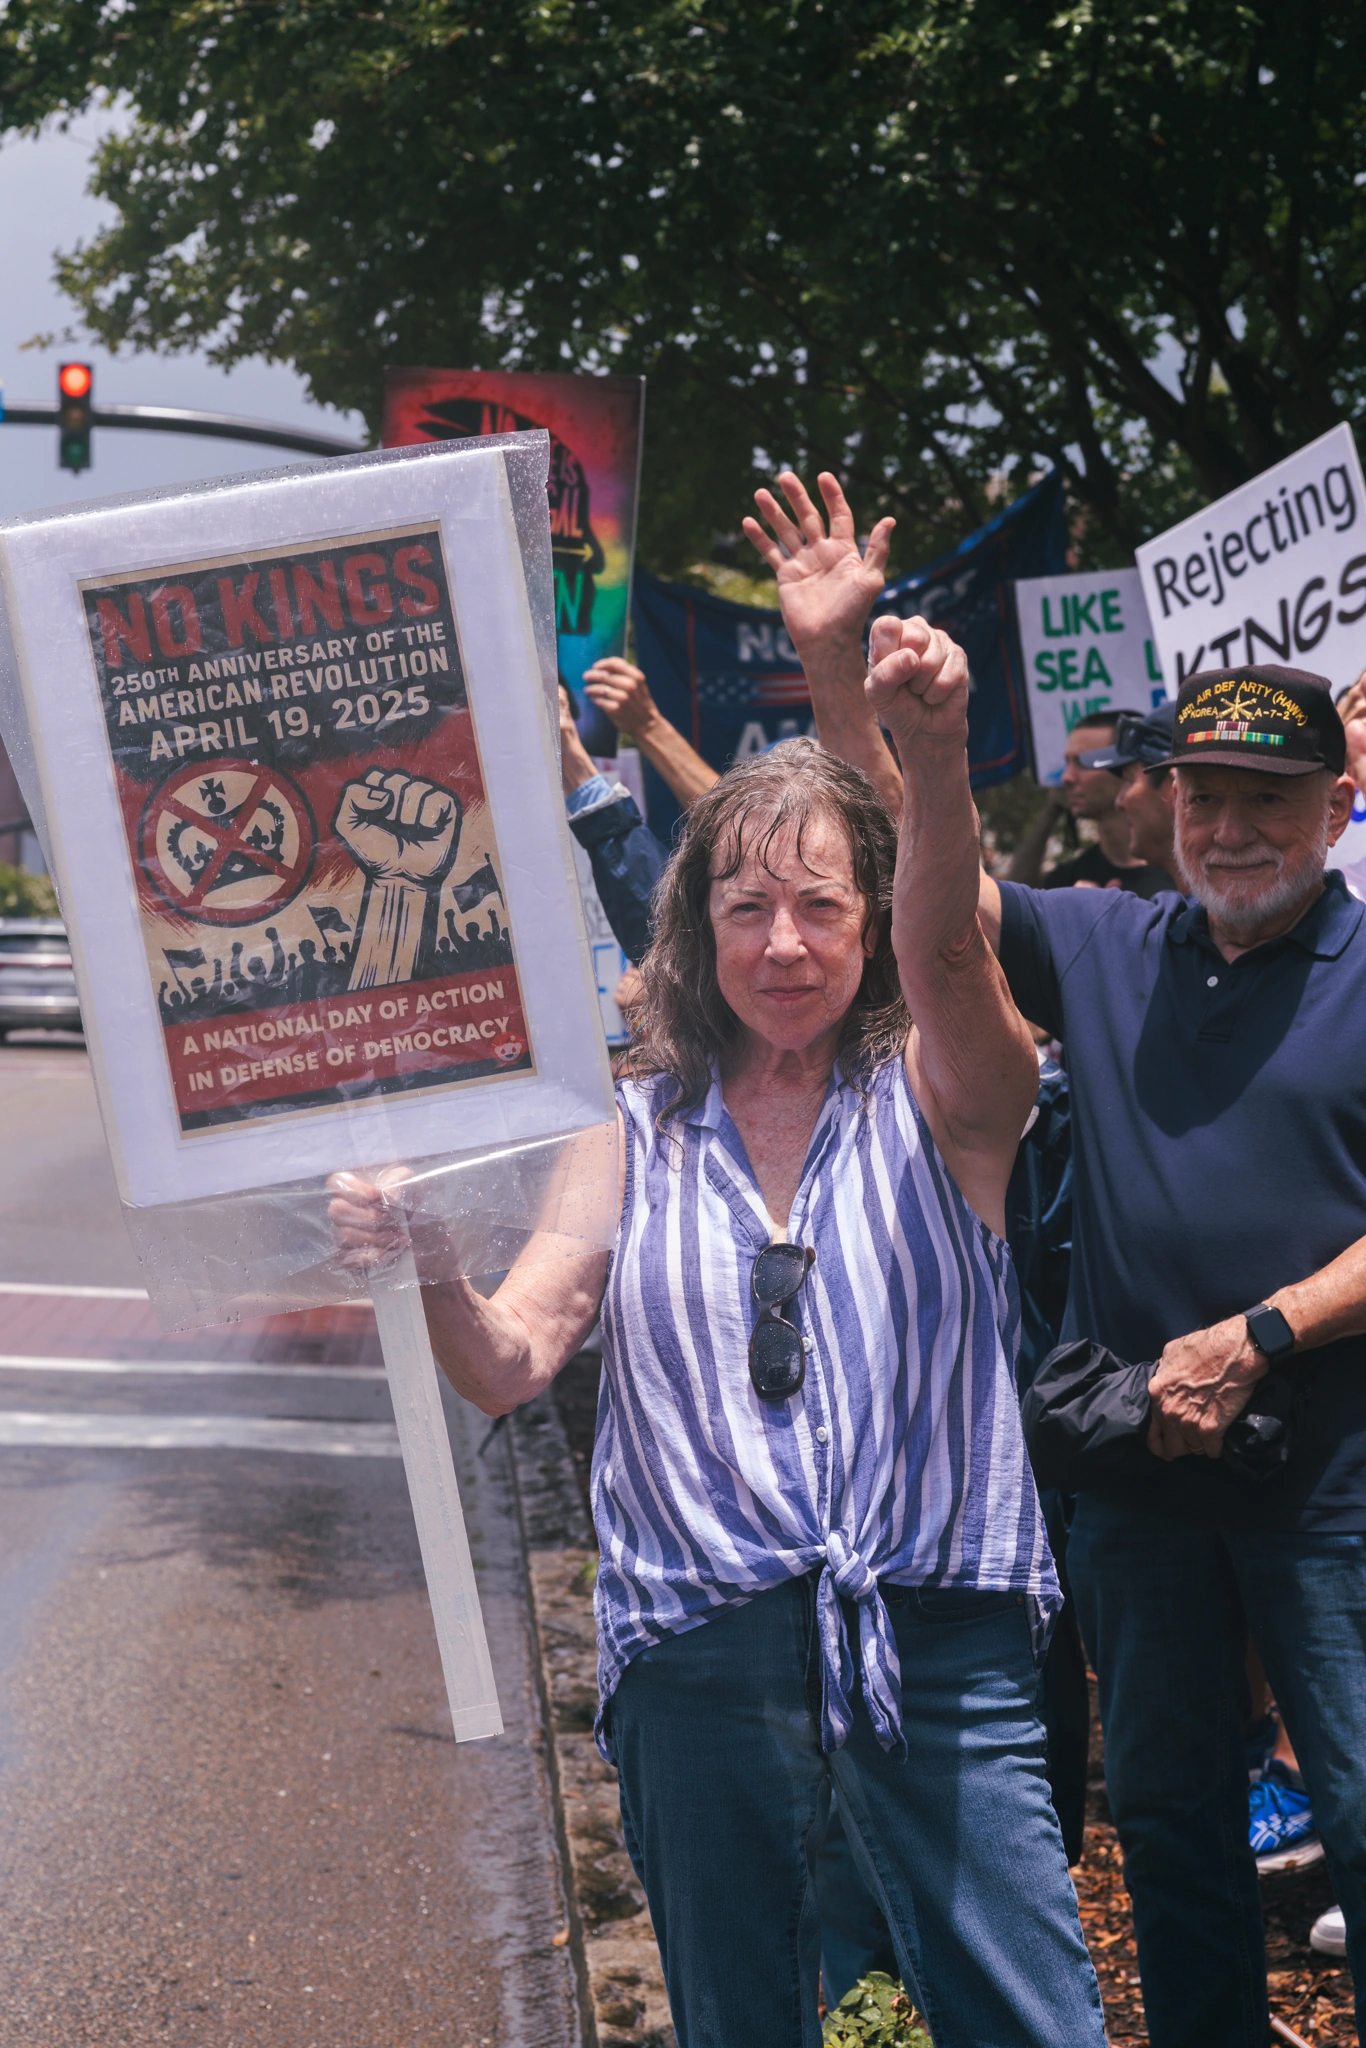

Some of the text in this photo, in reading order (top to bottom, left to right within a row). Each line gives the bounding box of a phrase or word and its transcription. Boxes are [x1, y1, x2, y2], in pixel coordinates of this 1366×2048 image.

[1153, 464, 1356, 618] Rejecting
[96, 545, 440, 668] NO KINGS
[1042, 589, 1124, 637] LIKE
[110, 622, 446, 696] 250TH ANNIVERSARY OF THE
[118, 646, 449, 726] AMERICAN REVOLUTION
[1034, 647, 1112, 692] SEA
[150, 685, 430, 761] APRIL 19, 2025
[1190, 706, 1219, 719] KOREA
[1196, 688, 1212, 706] AIR
[1214, 680, 1236, 695] DEF
[1238, 680, 1273, 698] ARTY
[1272, 690, 1308, 727] (HAWK)
[1254, 707, 1290, 721] A-7-2
[183, 980, 505, 1056] A NATIONAL DAY OF ACTION
[188, 1016, 510, 1092] IN DEFENSE OF DEMOCRACY
